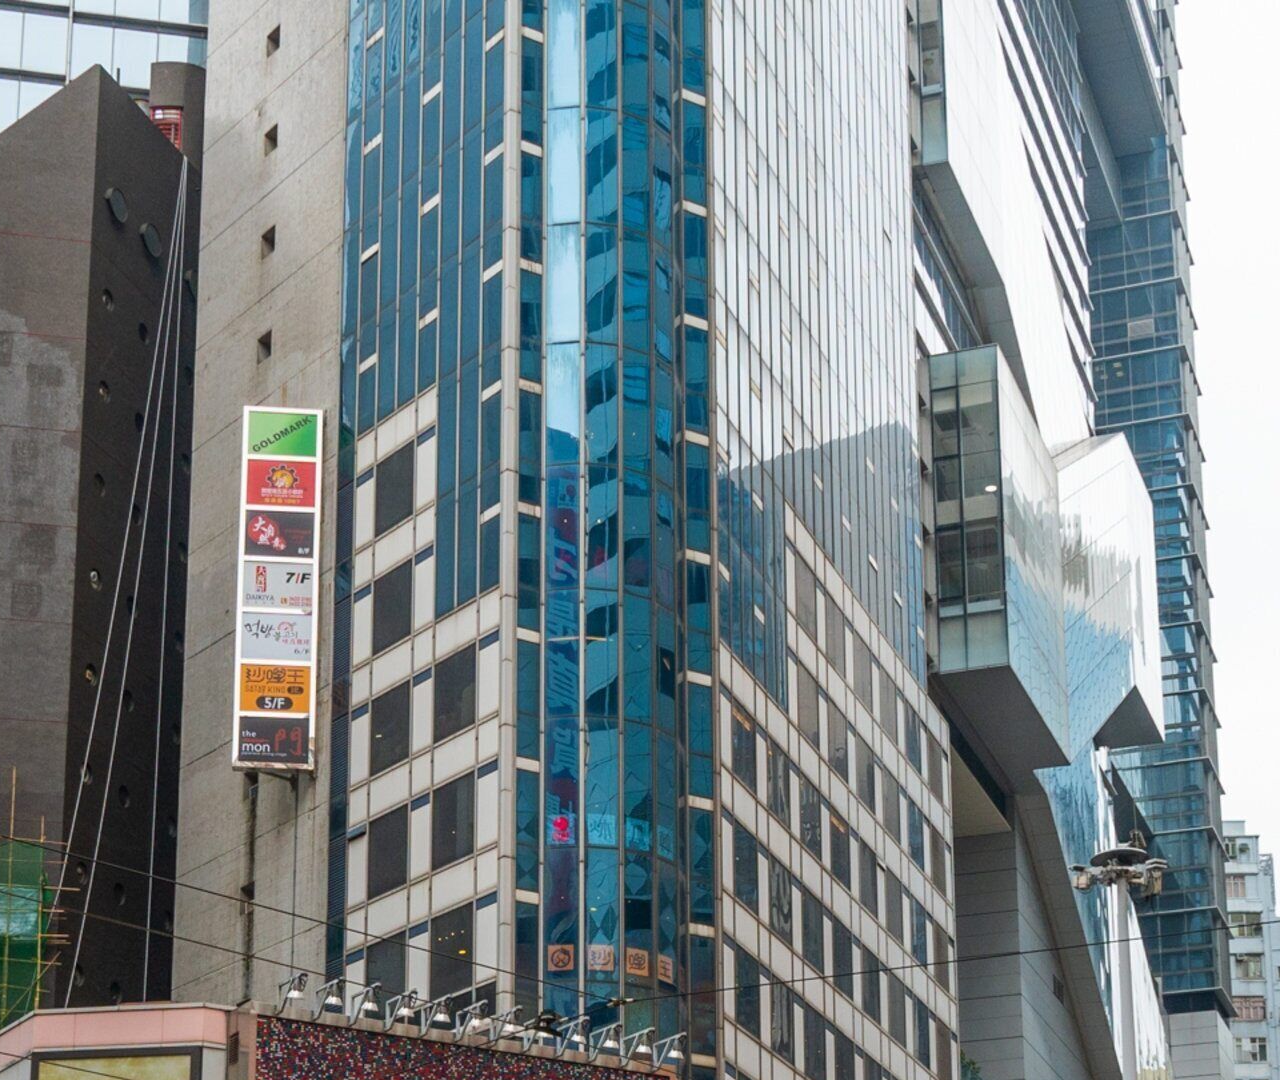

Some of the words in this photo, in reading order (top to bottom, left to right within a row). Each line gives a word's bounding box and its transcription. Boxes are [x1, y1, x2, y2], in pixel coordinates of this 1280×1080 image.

[251, 415, 313, 453] GOLDMARK
[263, 697, 286, 710] 5/F
[242, 729, 257, 738] the
[241, 742, 271, 753] mon
